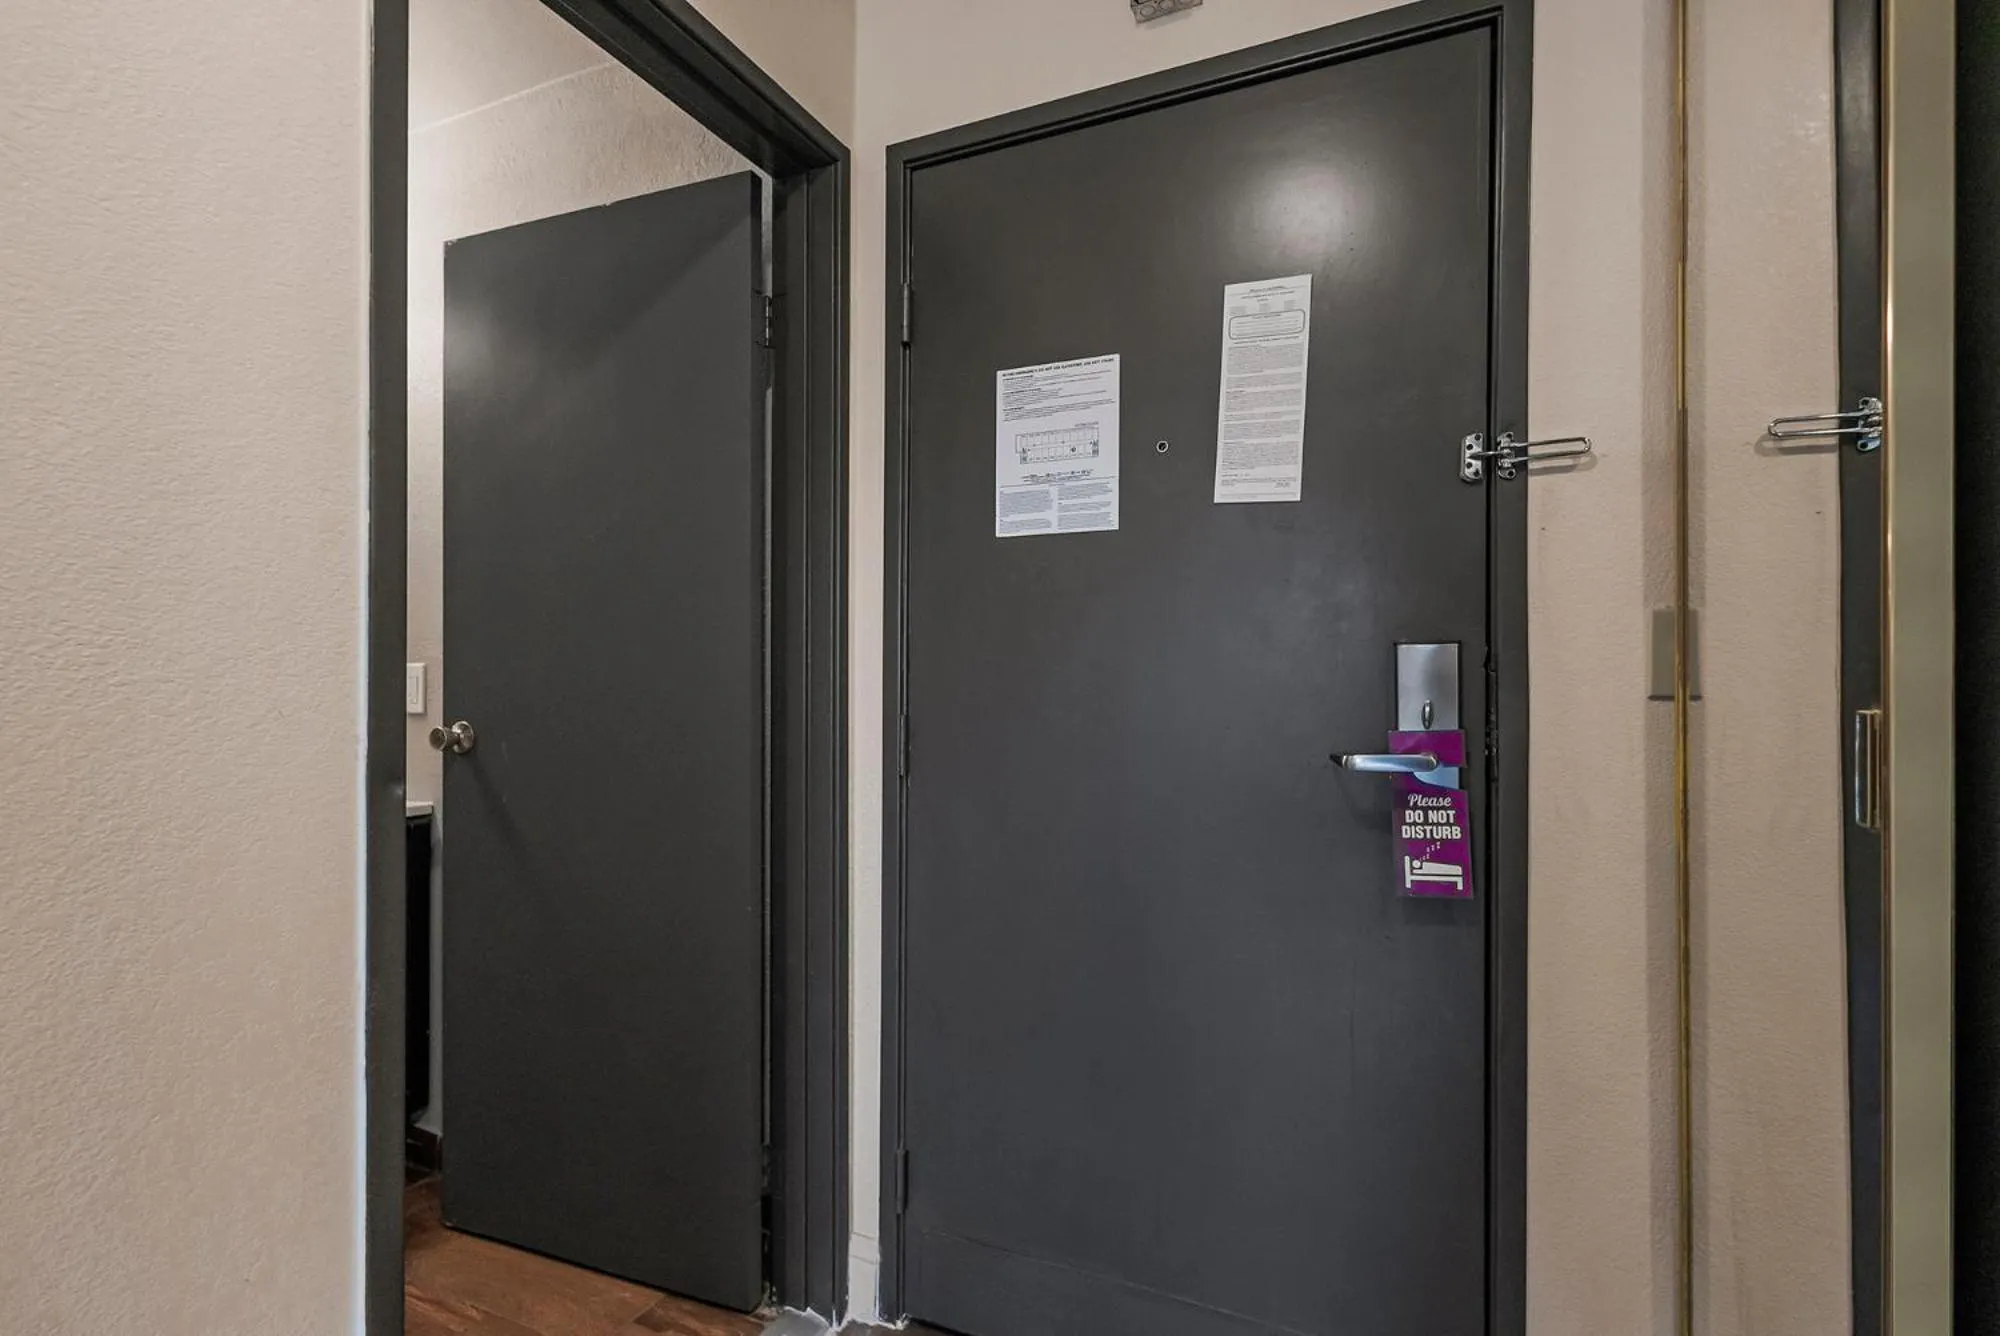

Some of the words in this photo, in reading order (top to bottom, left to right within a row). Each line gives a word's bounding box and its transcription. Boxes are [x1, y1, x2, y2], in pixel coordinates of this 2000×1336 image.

[1407, 793, 1452, 807] Please
[1405, 810, 1424, 823] DO
[1428, 810, 1456, 823] NOT
[1401, 825, 1462, 839] DISTURB
